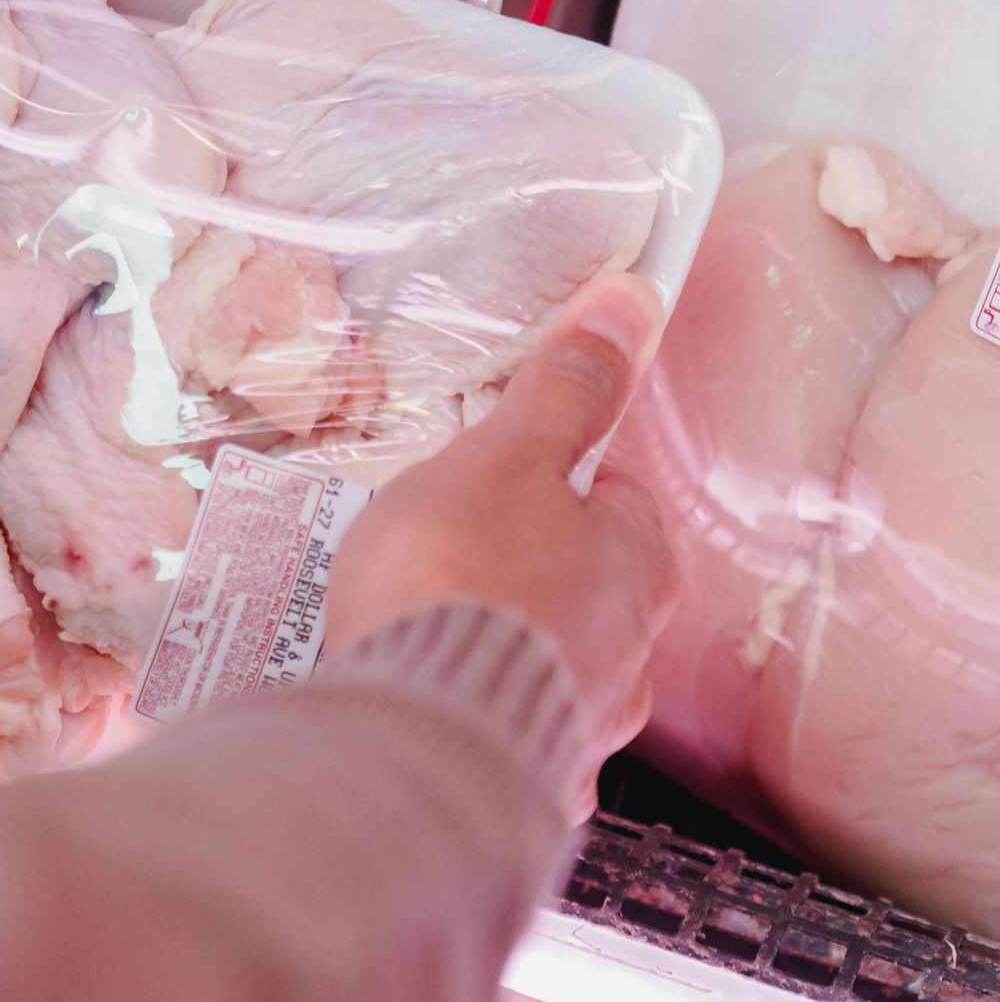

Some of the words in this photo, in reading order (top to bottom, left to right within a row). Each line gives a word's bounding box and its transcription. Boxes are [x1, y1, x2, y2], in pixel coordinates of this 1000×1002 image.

[314, 475, 344, 530] 61-27
[290, 523, 307, 555] SAFE
[269, 556, 296, 616] HANDLING
[281, 536, 325, 629] ROOSEVELT
[292, 581, 328, 645] DOLLAR
[267, 635, 291, 668] AVE
[286, 650, 303, 663] &
